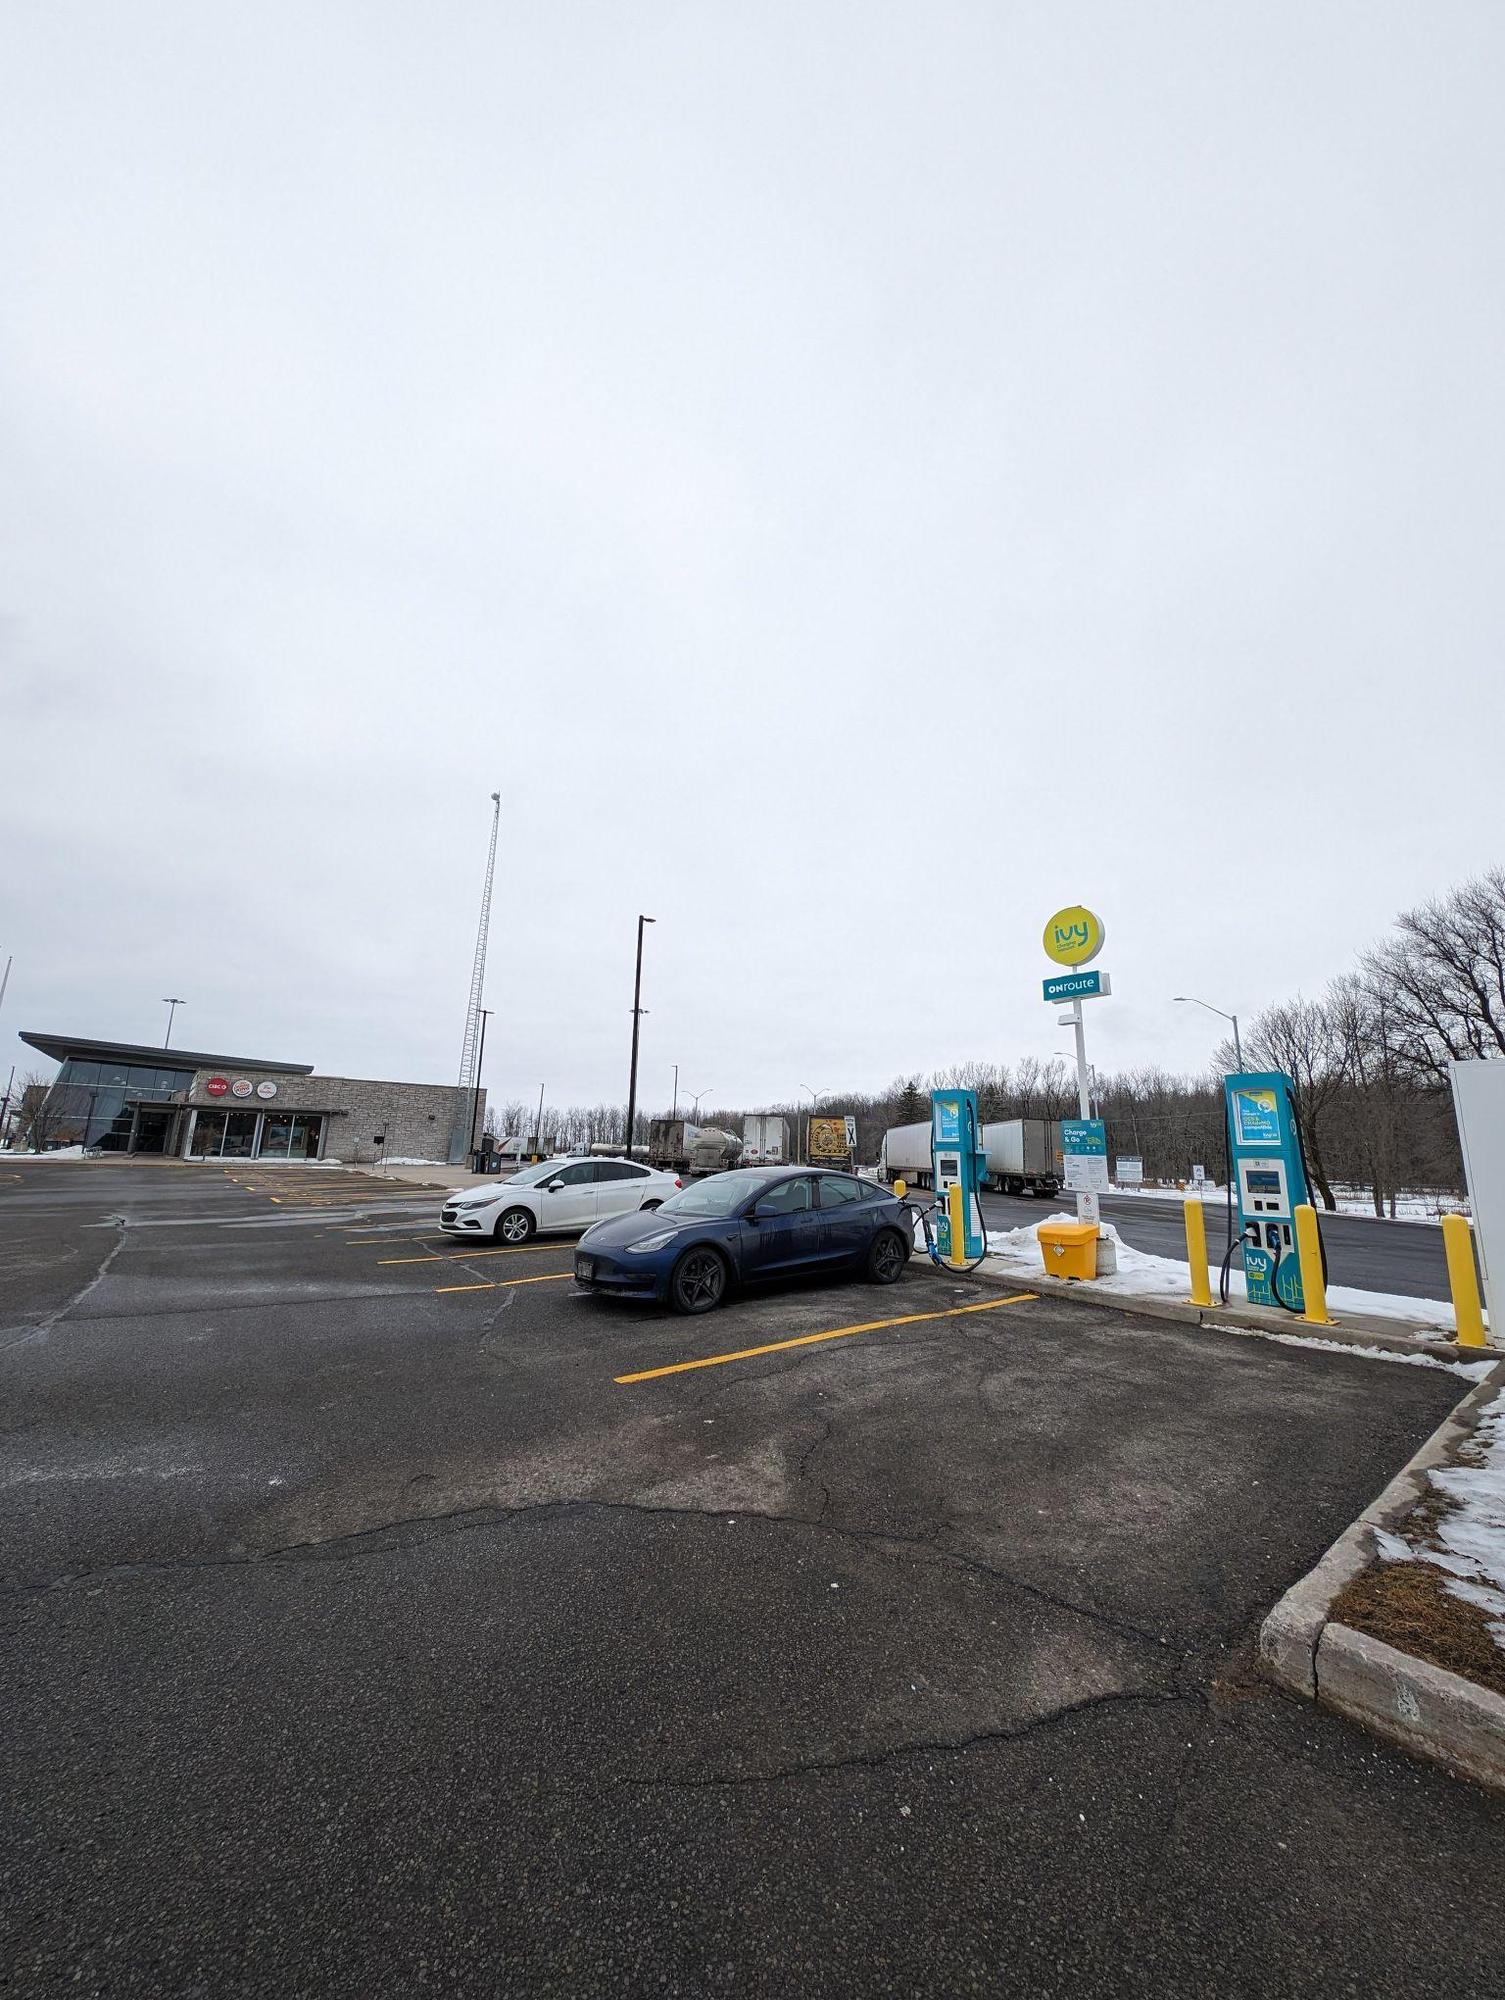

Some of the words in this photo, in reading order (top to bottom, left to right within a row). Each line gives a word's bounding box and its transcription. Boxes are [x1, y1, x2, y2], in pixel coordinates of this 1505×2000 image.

[1055, 921, 1088, 947] ivy
[1048, 978, 1095, 994] ONroute
[1064, 1128, 1087, 1137] Charge
[1245, 1253, 1267, 1272] ivy
